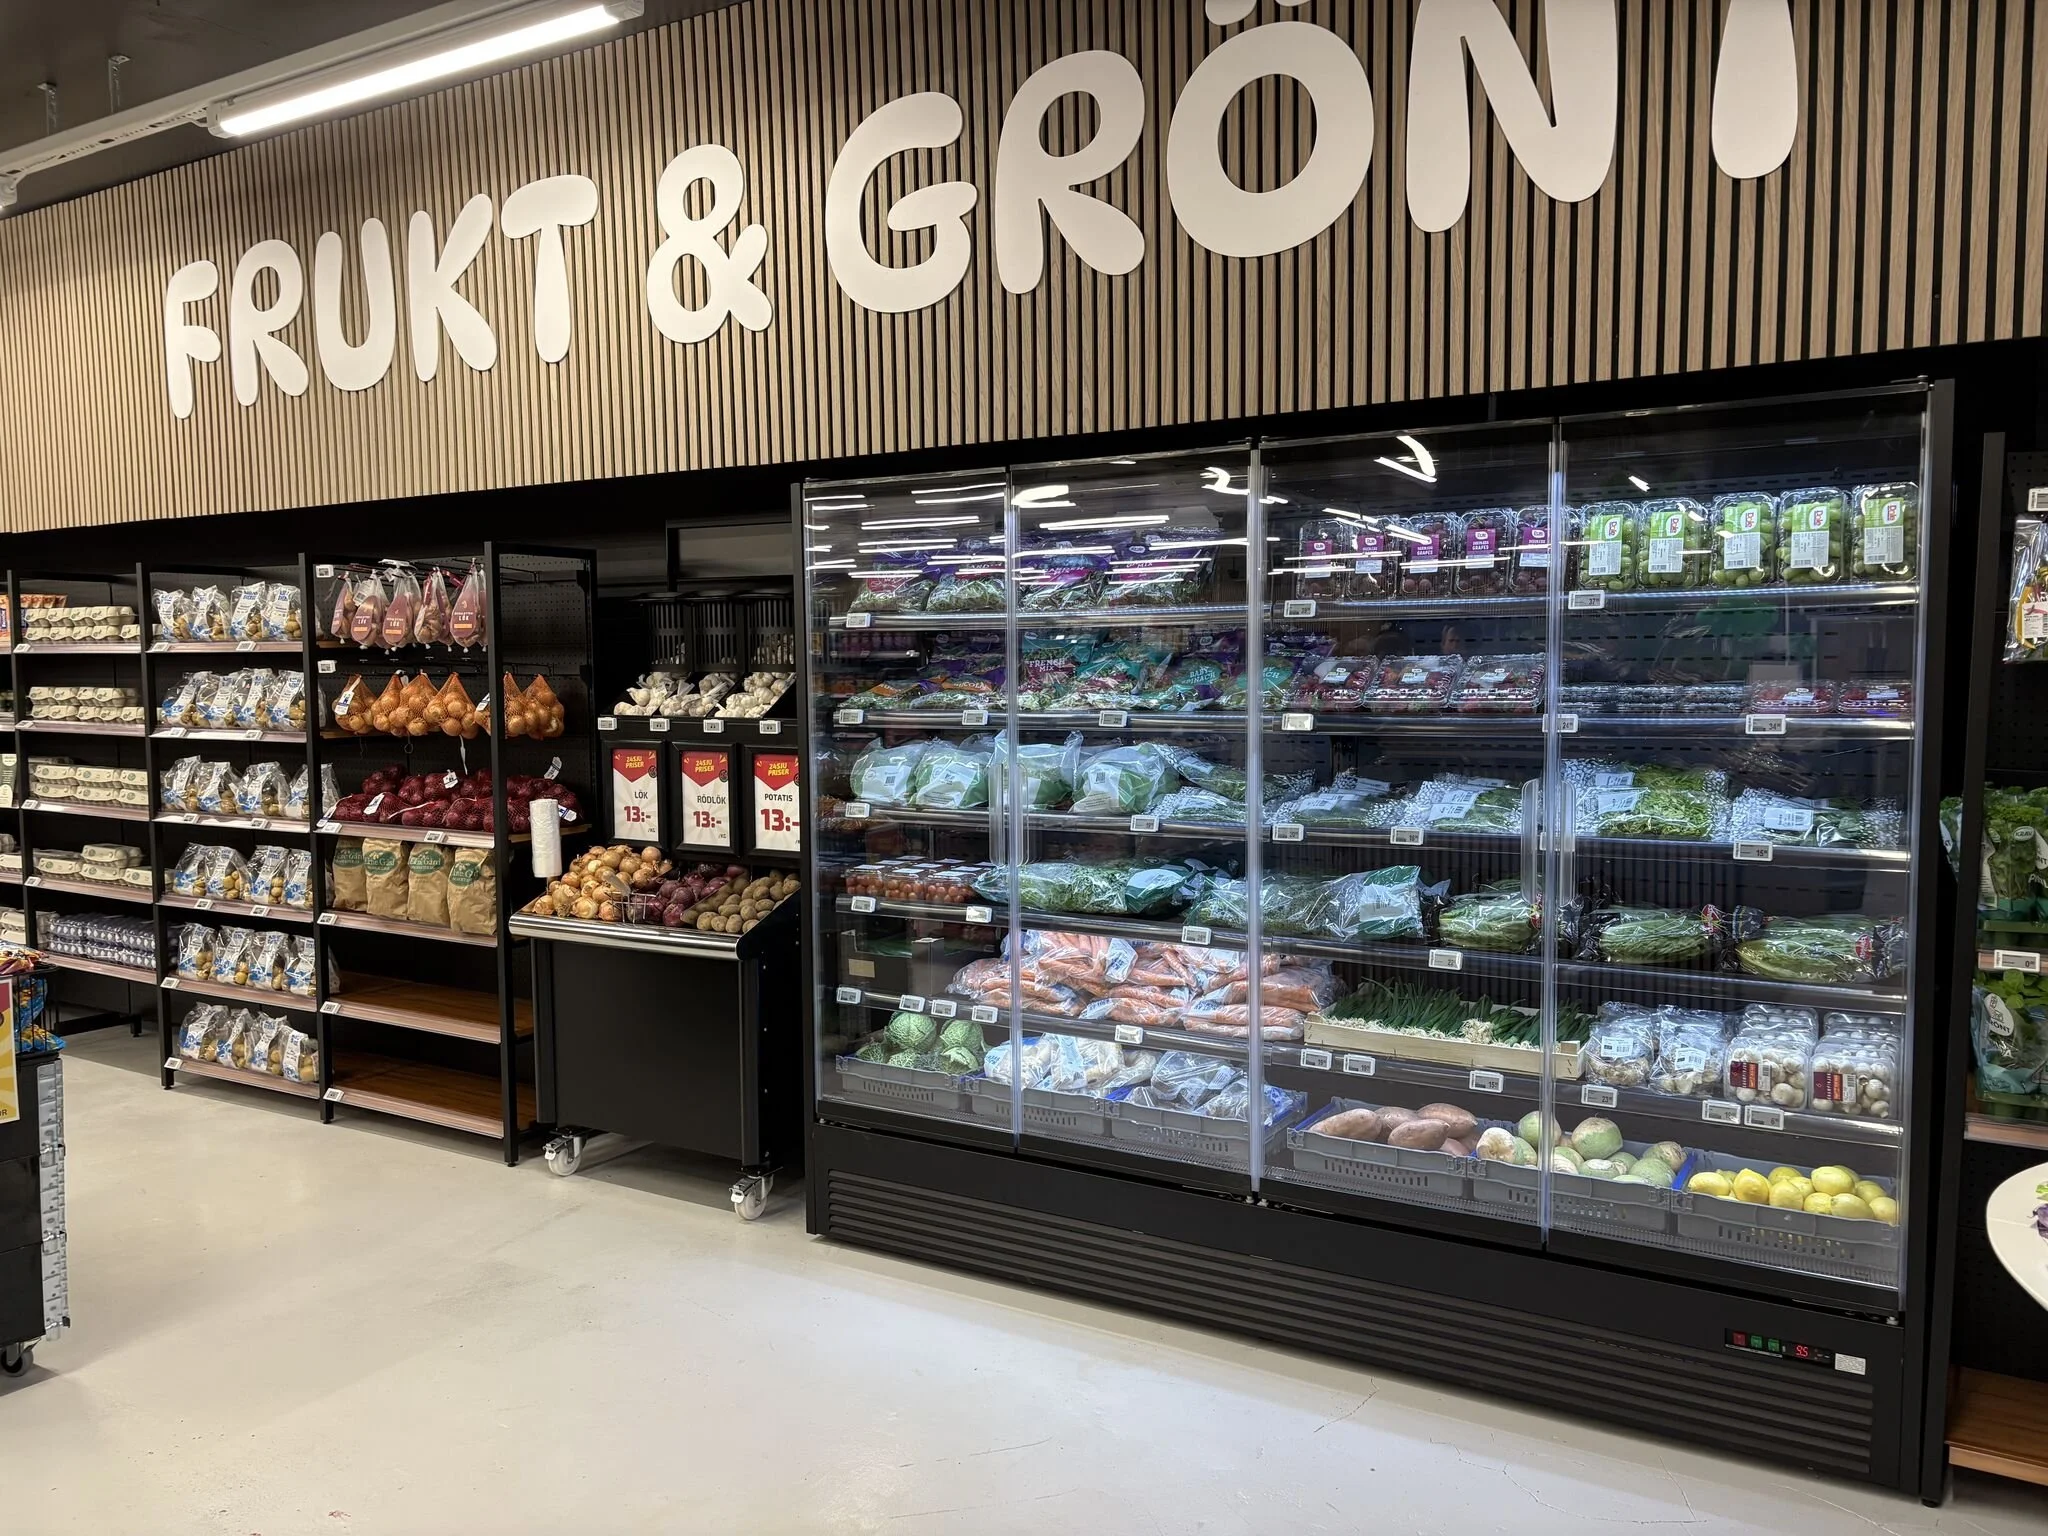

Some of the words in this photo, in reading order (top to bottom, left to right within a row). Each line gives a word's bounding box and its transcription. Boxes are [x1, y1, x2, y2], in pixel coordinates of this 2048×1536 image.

[164, 174, 599, 419] FRUKT
[647, 143, 774, 345] &
[768, 768, 790, 776] PRISER
[634, 789, 648, 799] LÖK
[697, 794, 726, 804] RÖDLÖK
[764, 793, 793, 802] POTATIS
